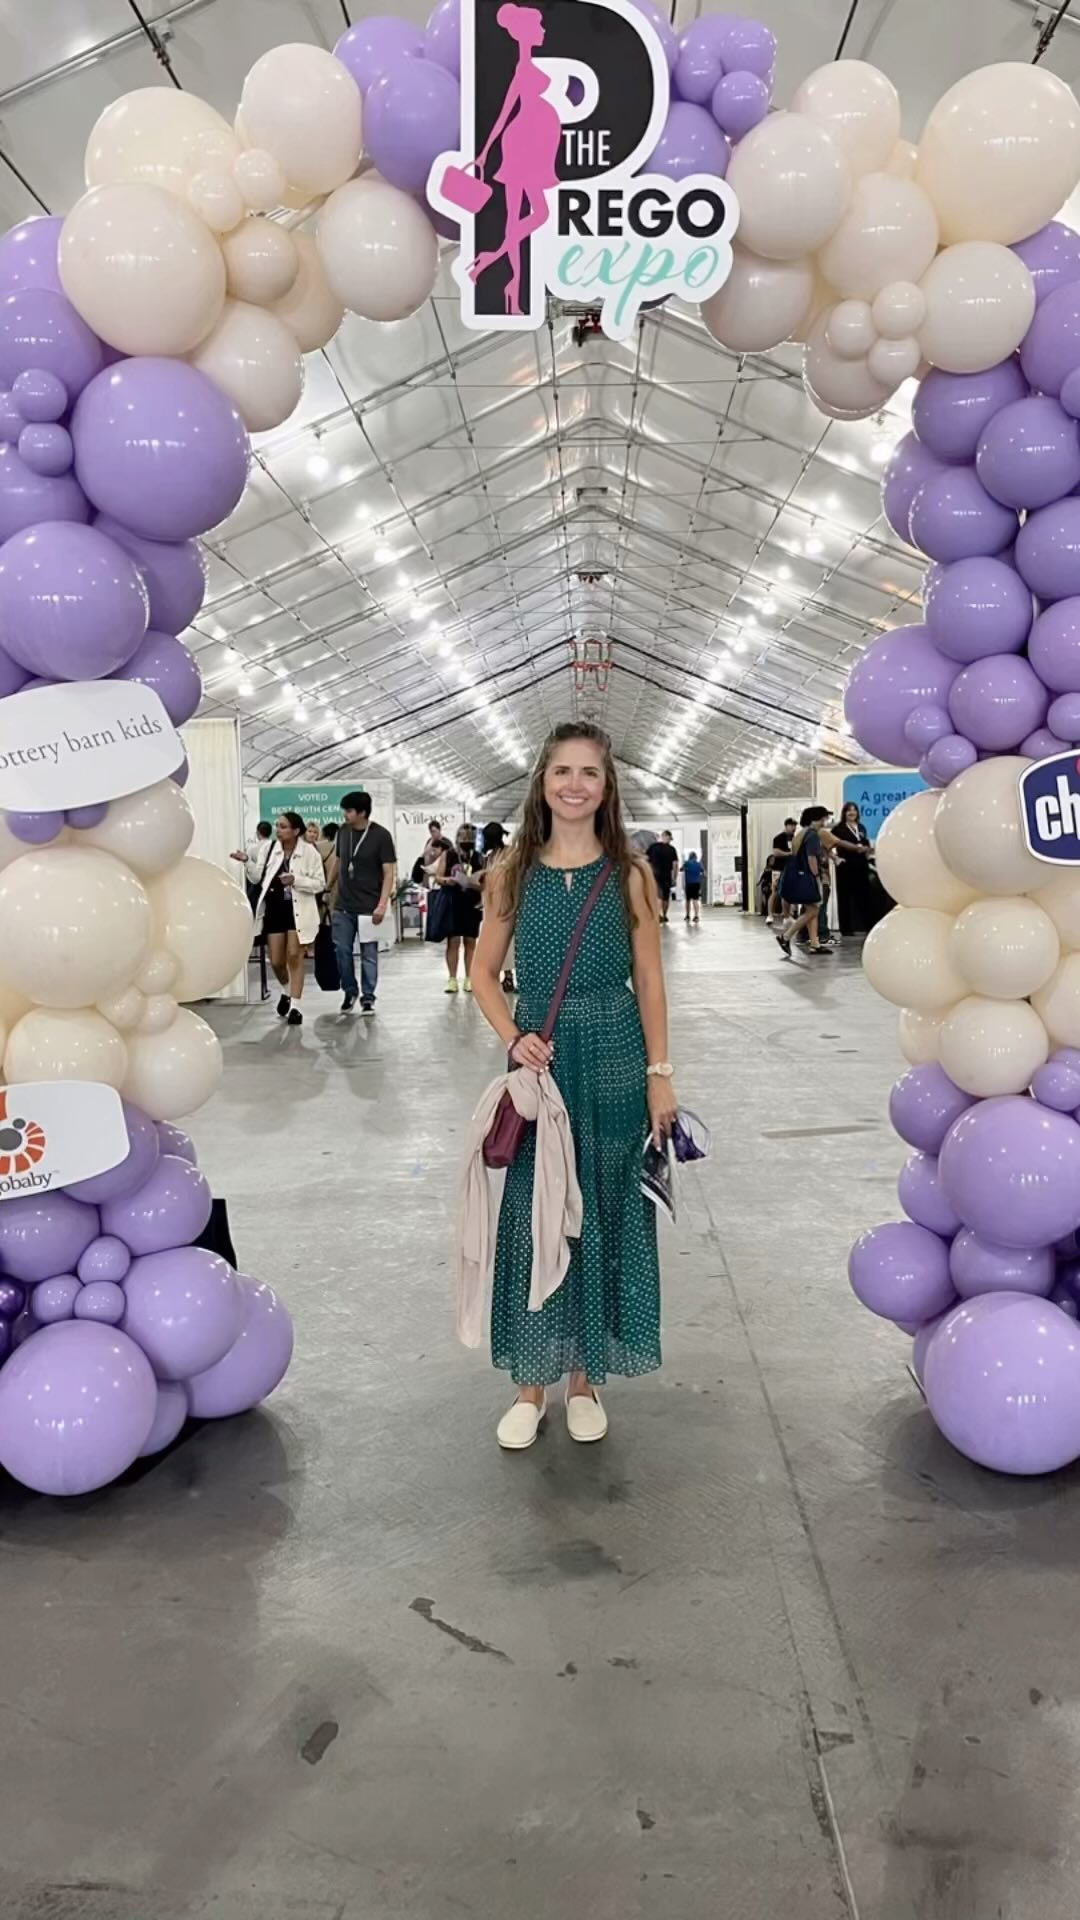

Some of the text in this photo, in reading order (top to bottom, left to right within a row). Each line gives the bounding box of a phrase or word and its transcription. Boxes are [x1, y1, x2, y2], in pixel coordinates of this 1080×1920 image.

[562, 129, 611, 166] THE
[557, 188, 726, 238] REGO
[557, 240, 719, 328] expo
[0, 714, 163, 770] ottery barn kids
[271, 804, 341, 815] BEST BIRTH CEN
[298, 793, 329, 802] VOTED
[860, 791, 870, 802] A
[873, 791, 907, 805] great
[860, 805, 879, 817] for
[1035, 775, 1080, 841] ch
[0, 1171, 52, 1196] obaby
